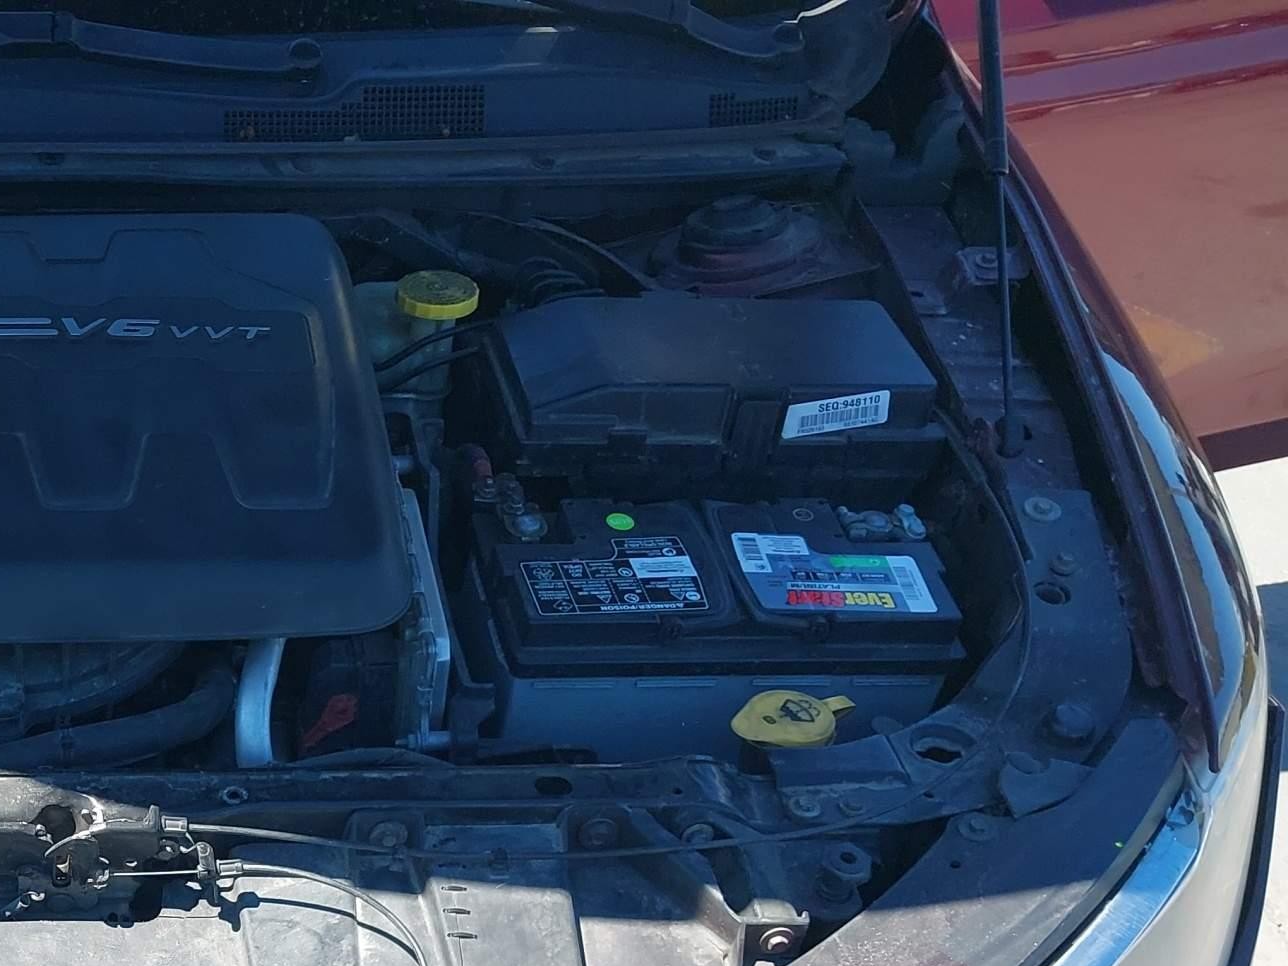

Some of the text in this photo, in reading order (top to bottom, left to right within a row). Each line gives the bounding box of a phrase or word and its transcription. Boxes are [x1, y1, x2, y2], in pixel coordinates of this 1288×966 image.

[62, 317, 271, 339] V6 VVT
[818, 395, 880, 413] SEQ:948110
[786, 590, 896, 608] EverStart
